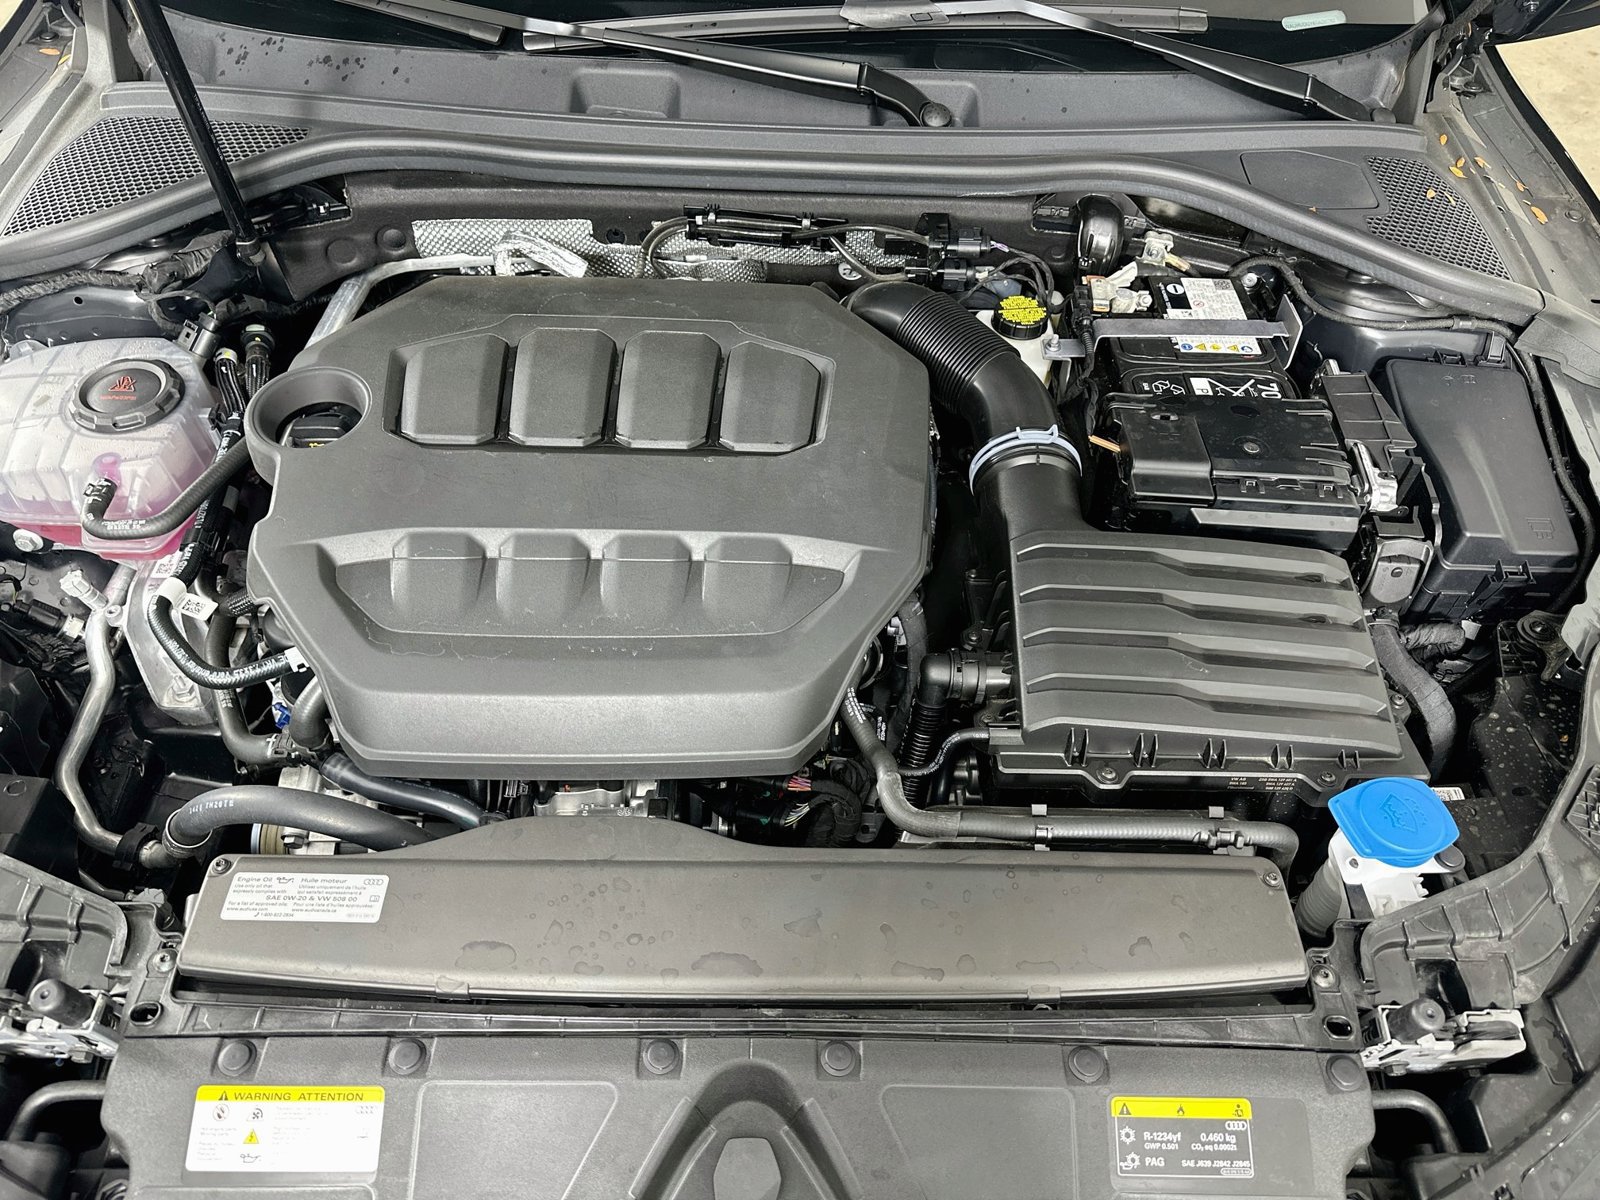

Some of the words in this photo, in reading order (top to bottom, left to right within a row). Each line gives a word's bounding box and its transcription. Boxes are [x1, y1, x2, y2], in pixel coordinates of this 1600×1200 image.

[1256, 382, 1282, 398] 70
[234, 1092, 291, 1100] WARNING
[298, 1092, 364, 1101] ATTENTION
[1143, 1132, 1181, 1142] R-1234yf
[1200, 1133, 1224, 1142] 0.460
[1225, 1133, 1236, 1143] kg
[1145, 1157, 1165, 1167] PAG
